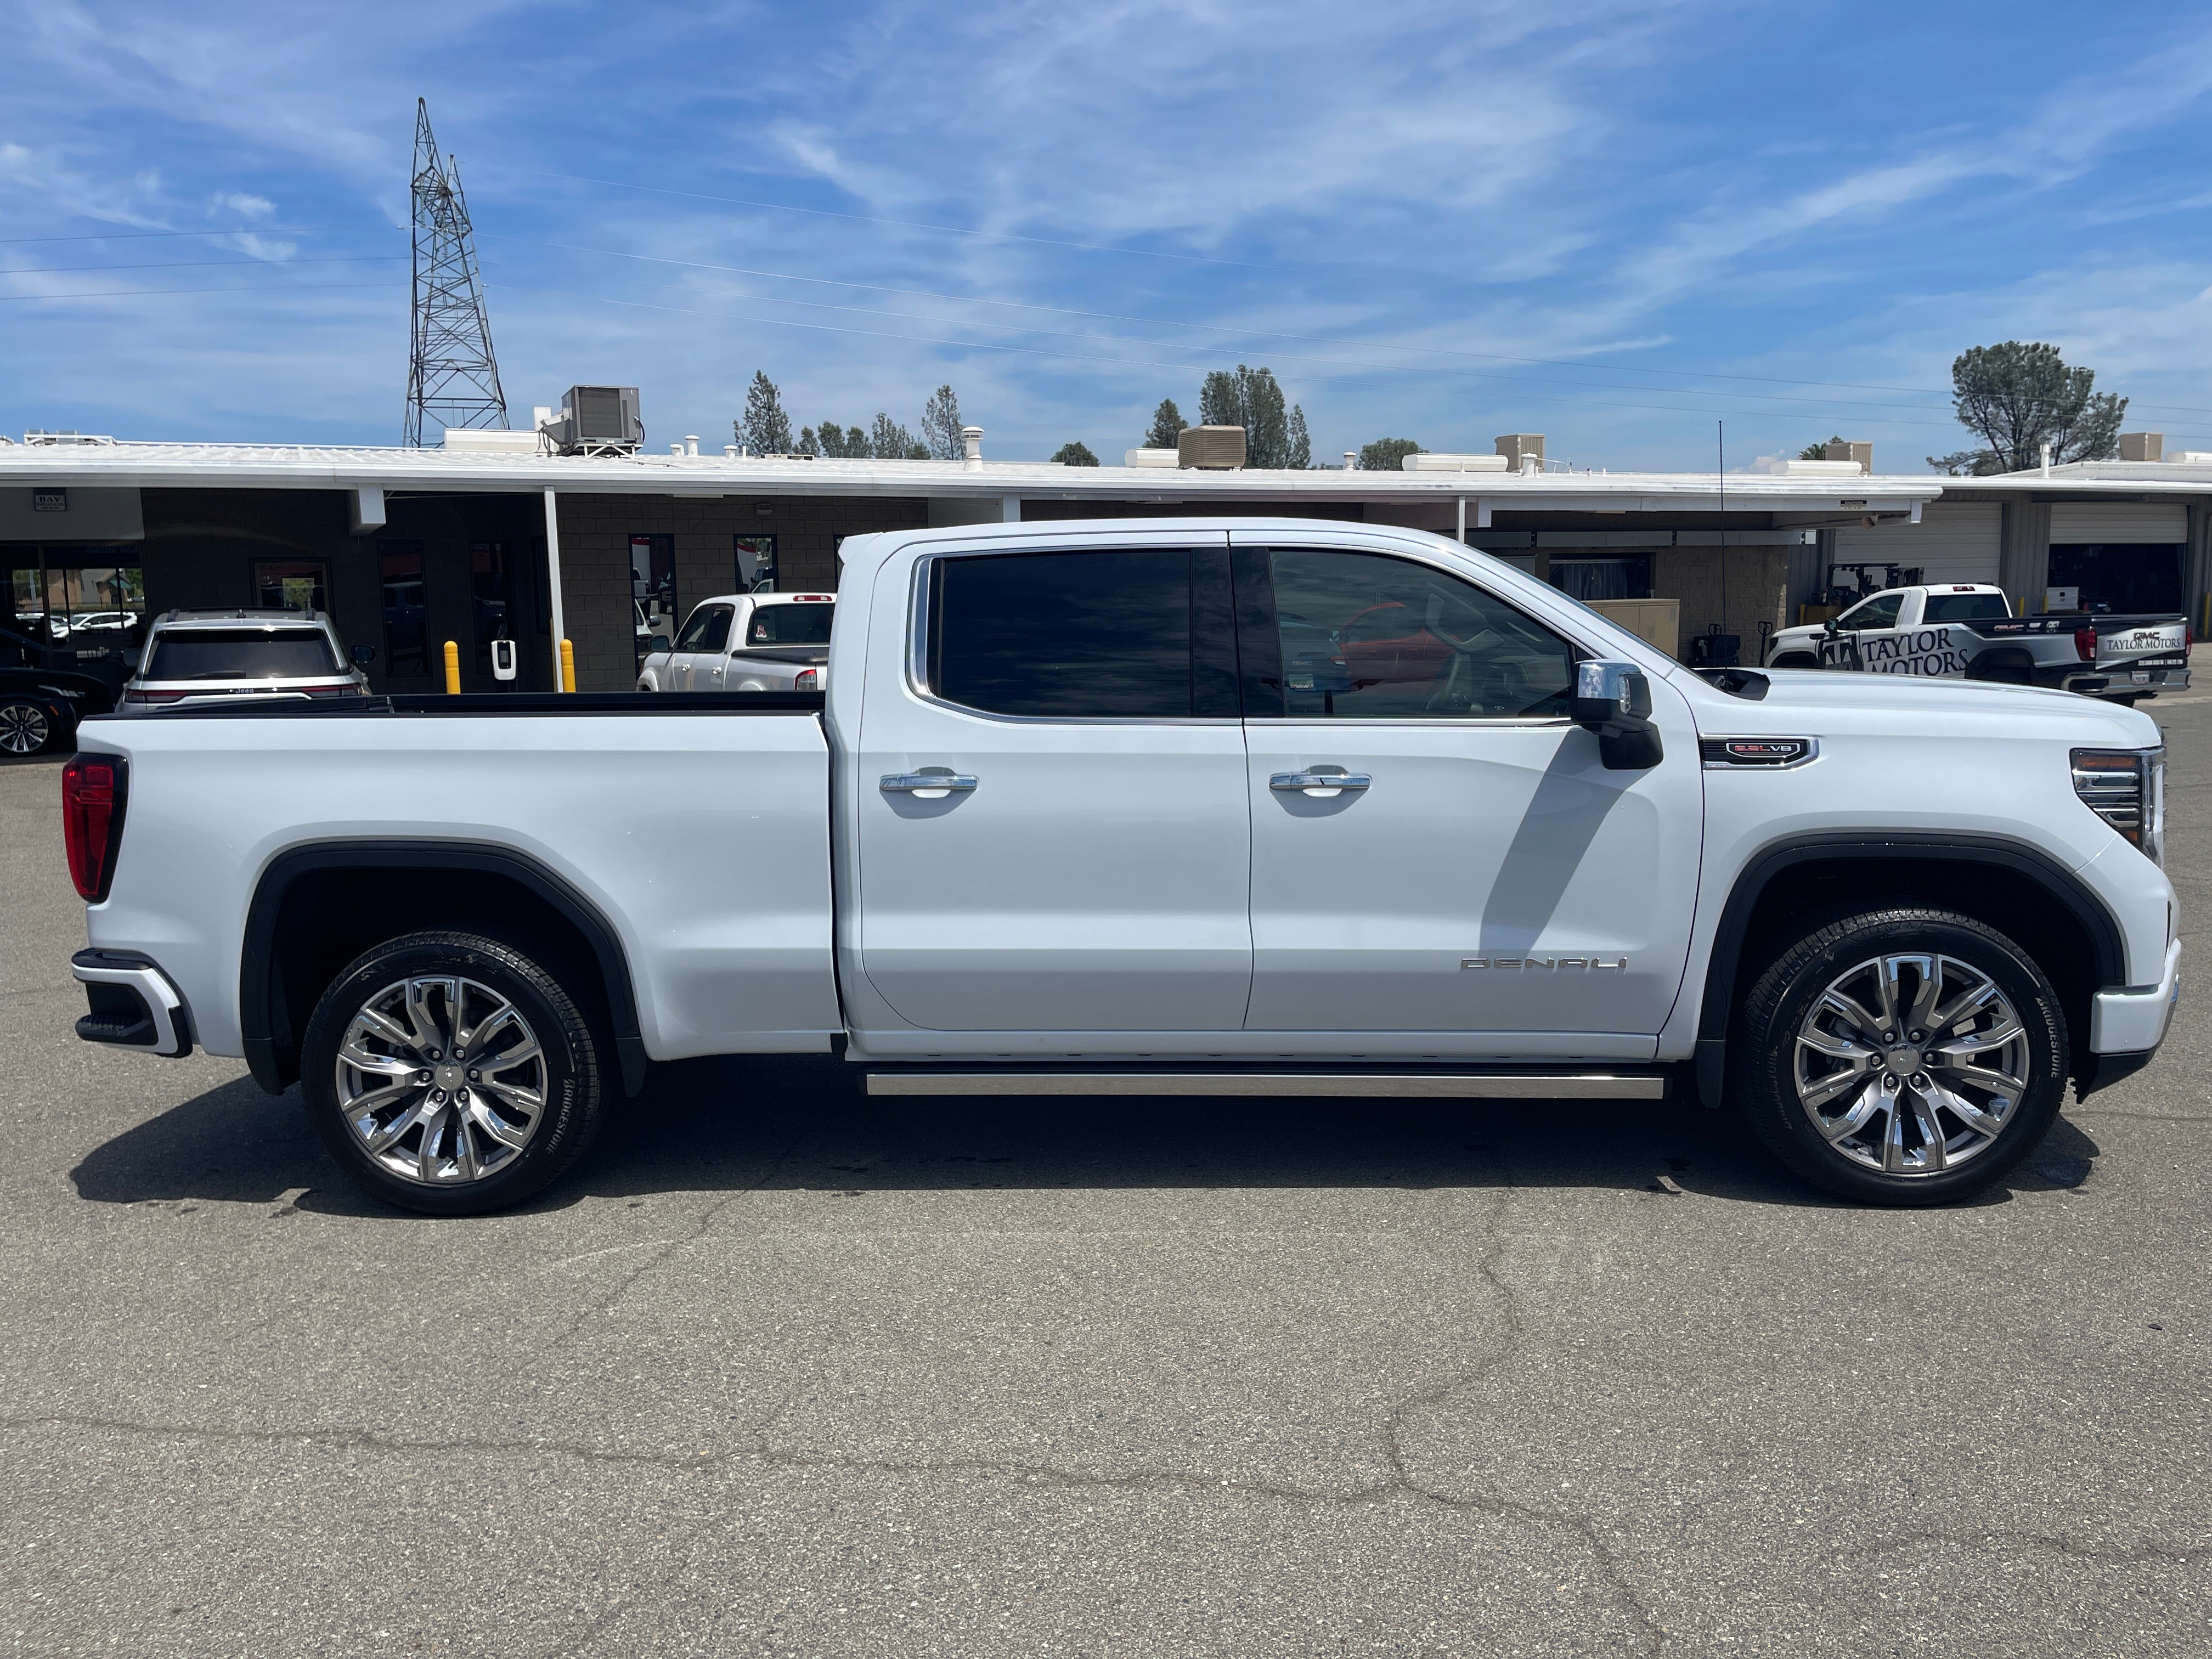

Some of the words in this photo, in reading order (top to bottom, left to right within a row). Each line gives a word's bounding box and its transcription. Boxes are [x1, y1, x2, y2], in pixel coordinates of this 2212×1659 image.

[1862, 628, 1954, 662] TAYLOR
[2107, 639, 2143, 650] TAYLOR
[2145, 638, 2181, 650] MOTORS
[2134, 631, 2160, 640] GMC
[1460, 957, 1628, 969] DENALI
[2035, 996, 2061, 1079] BRIDGESTONE
[545, 1078, 575, 1155] BRIDGESTONE
